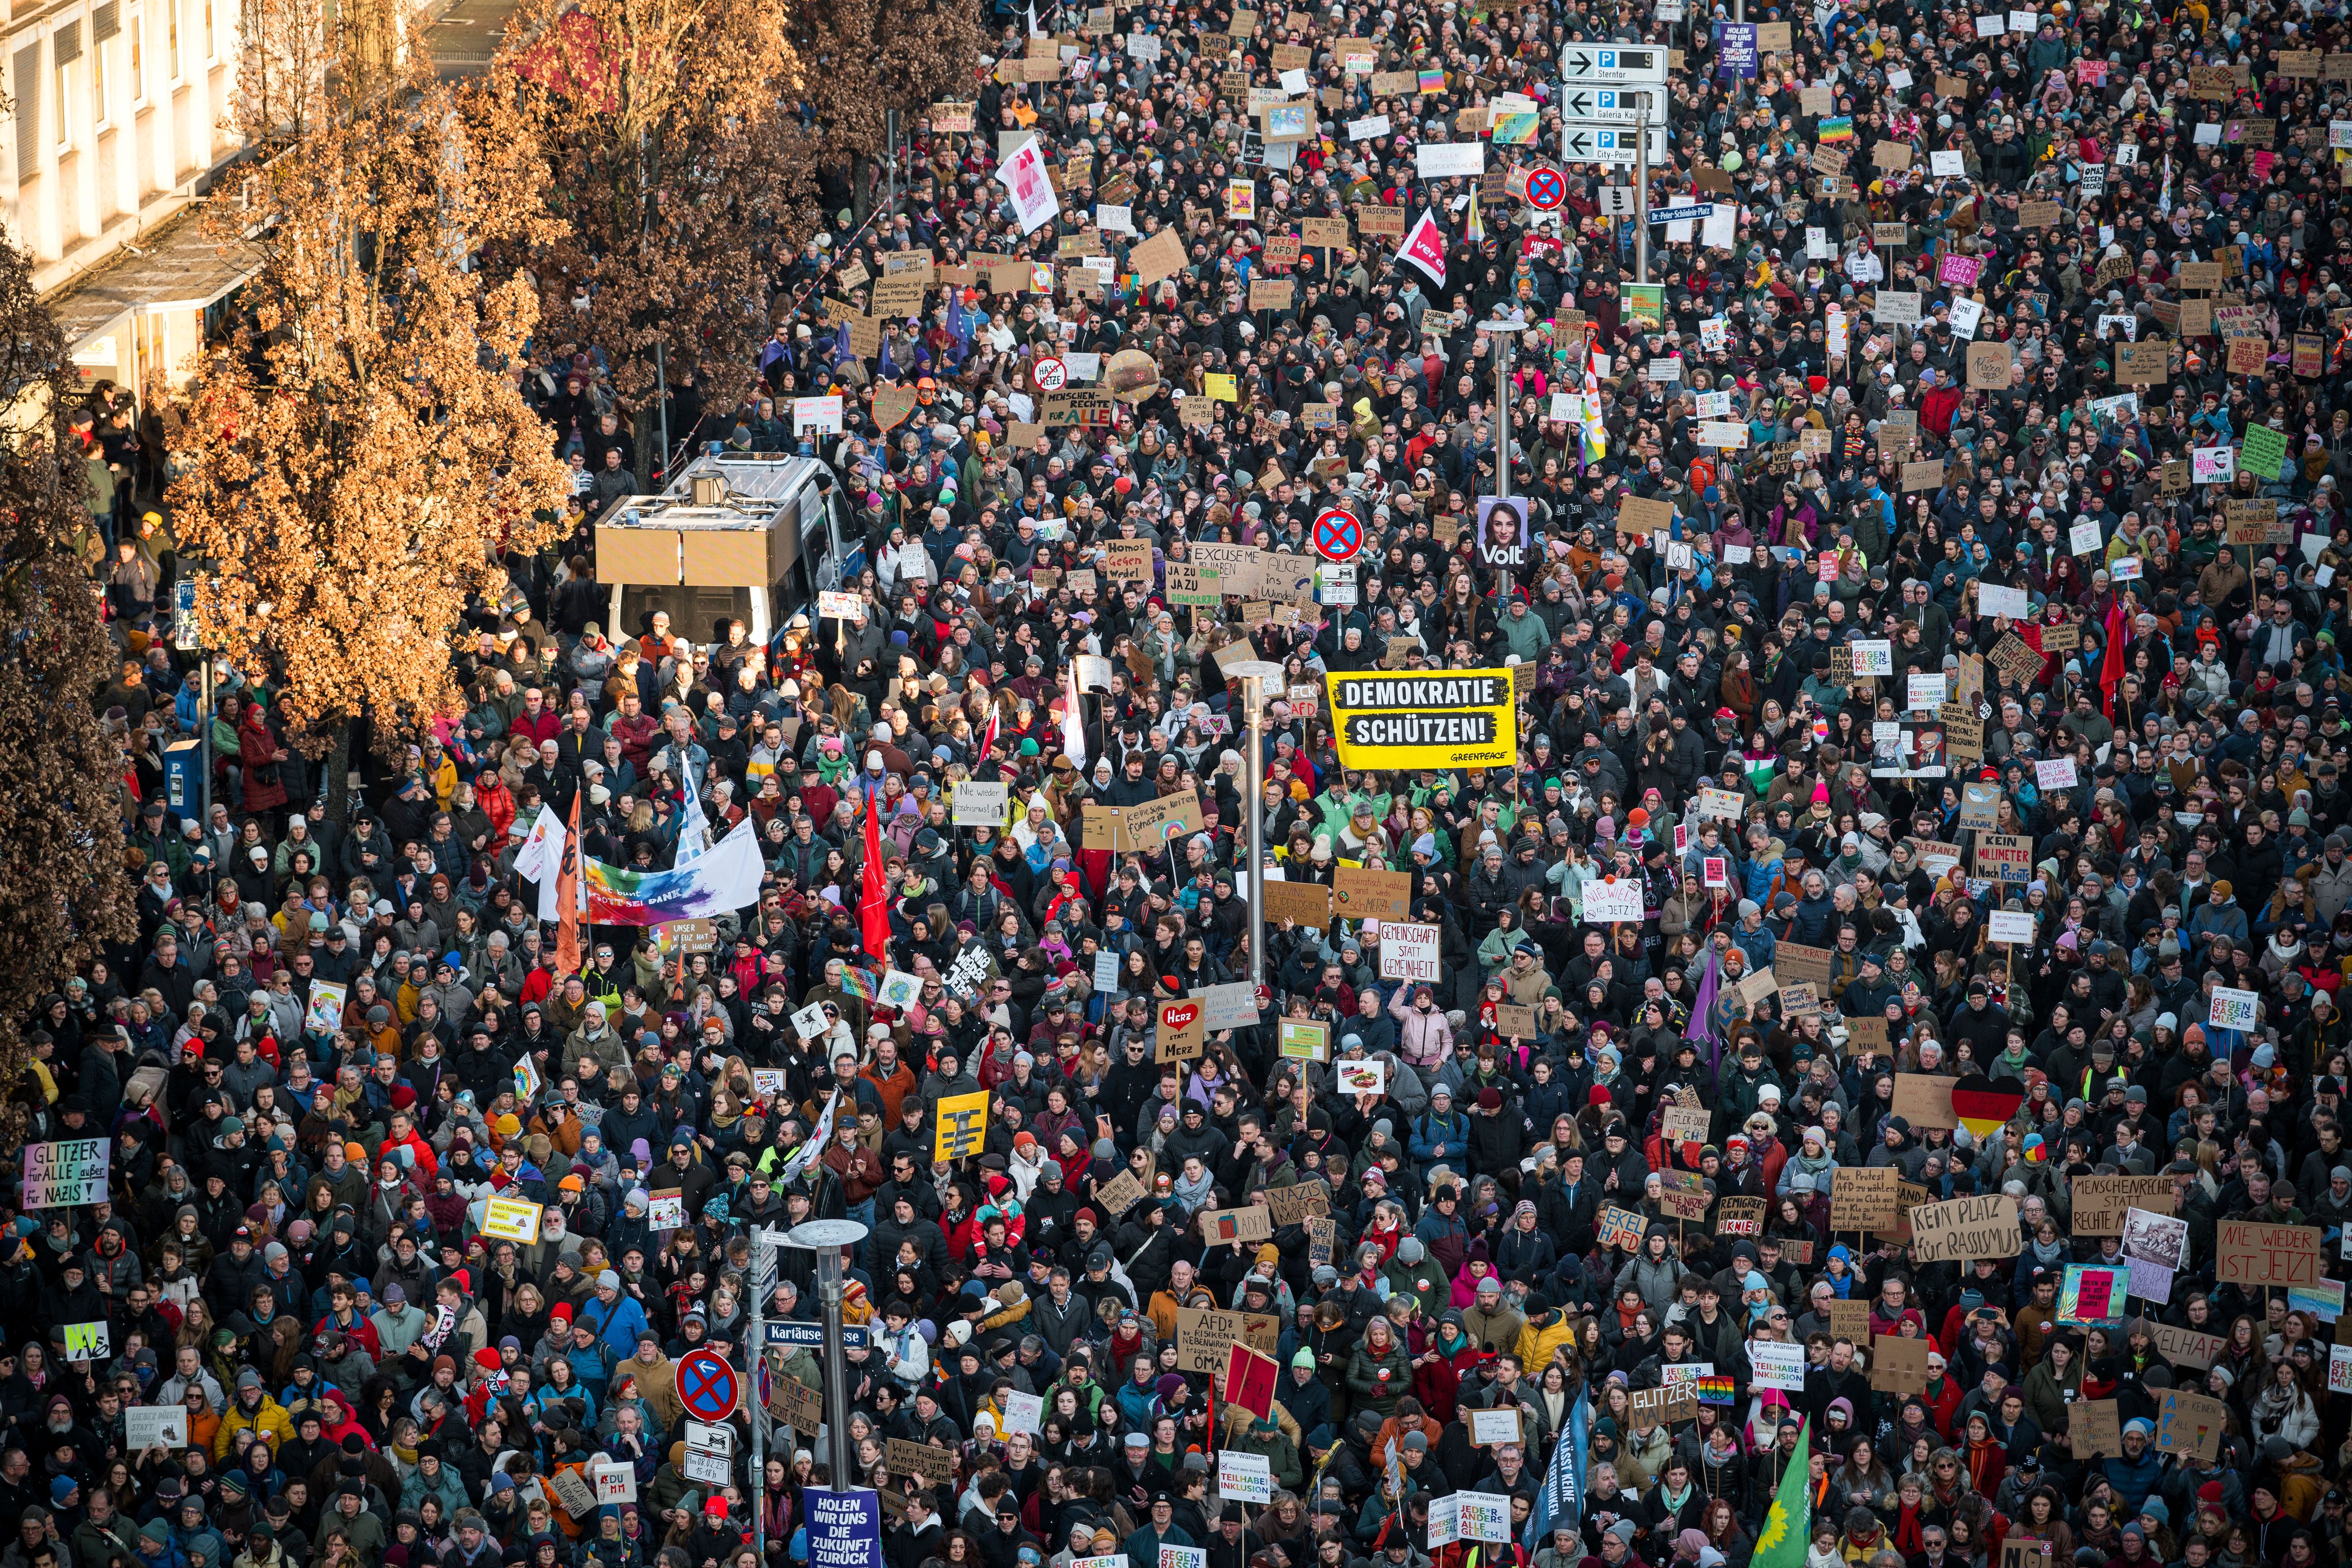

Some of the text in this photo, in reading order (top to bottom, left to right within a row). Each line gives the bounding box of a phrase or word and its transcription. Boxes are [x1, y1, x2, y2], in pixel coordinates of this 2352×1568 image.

[1203, 36, 1227, 49] SAFD
[1202, 48, 1227, 60] LADEN
[1601, 53, 1611, 65] P
[1601, 93, 1611, 106] P
[1598, 110, 1621, 119] Galeria
[1601, 134, 1611, 146] P
[1597, 150, 1632, 160] City-Point
[2085, 167, 2104, 175] OMAS
[1652, 207, 1710, 221] Dr.-Peter-Schönlein-Platz
[1273, 246, 1291, 255] AFD
[1416, 240, 1445, 272] ver.di
[1945, 256, 1980, 270] HOT GIRLS
[1946, 264, 1971, 275] GEGEN
[876, 279, 921, 290] Rassismus ist
[891, 289, 918, 298] Meinung
[873, 305, 903, 316] Bildung
[1048, 392, 1101, 402] MENSCHEN-
[1070, 400, 1109, 408] RECHTE
[1049, 409, 1109, 424] FÜR ALLE
[901, 545, 921, 553] NAZIS
[1480, 543, 1525, 565] Volt
[901, 553, 921, 561] ESSEN
[901, 560, 923, 569] HEIMLICH
[1168, 566, 1180, 576] JA
[1183, 567, 1196, 576] ZU
[1170, 579, 1199, 591] JA ZU
[1291, 685, 1317, 699] FCK
[1345, 679, 1494, 706] DEMOKRATIE
[1291, 702, 1316, 717] AFD
[1356, 713, 1486, 743] SCHÜTZEN!
[1450, 751, 1508, 763] GREENPEACE
[960, 784, 1000, 797] Nie wieder
[954, 801, 990, 814] Faschismus!
[1961, 803, 1996, 816] BLAUWAL
[1960, 818, 1994, 829] BLAUWAHL
[1985, 836, 2017, 847] KEIN
[1978, 847, 2029, 862] MILLIMETER
[1978, 865, 1999, 879] Nach
[1585, 886, 1643, 909] NIE WIEDER
[1607, 904, 1636, 916] JETZT
[1381, 924, 1438, 944] GEMEINSCHAFT
[1398, 945, 1421, 957] STATT
[1384, 959, 1435, 978] GEMEINHEIT
[1513, 1008, 1532, 1016] MENSCH
[1499, 1025, 1526, 1036] ILLEGAL
[34, 1141, 102, 1165] GLITZER
[28, 1165, 105, 1183] für ALLE außer
[2074, 1179, 2174, 1195] MENSCHENRECHTE
[26, 1190, 41, 1205] für
[2103, 1195, 2142, 1208] STATT
[491, 1203, 505, 1211] Nazis
[506, 1206, 523, 1214] hatten
[1959, 1195, 2003, 1224] PLATZ
[2074, 1211, 2111, 1231] RECHTE
[498, 1224, 520, 1234] scheiße!
[1917, 1227, 2021, 1261] für RASSISMUS
[2221, 1226, 2312, 1249] NIE WIEDER
[2221, 1249, 2318, 1284] IST JETZT
[131, 1409, 180, 1422] LIEBER DÜRER
[131, 1423, 155, 1431] STATT
[130, 1433, 157, 1442] FÜHRER
[892, 1443, 950, 1463] Wir haben
[891, 1453, 949, 1472] Angst um
[1221, 1473, 1265, 1485] TEILHABE
[1221, 1482, 1268, 1494] INKLUSION
[817, 1498, 861, 1512] HOLEN
[813, 1510, 868, 1525] WIR UNS
[828, 1525, 850, 1538] DIE
[812, 1536, 872, 1551] ZUKUNFT
[816, 1550, 869, 1564] ZURÜCK
